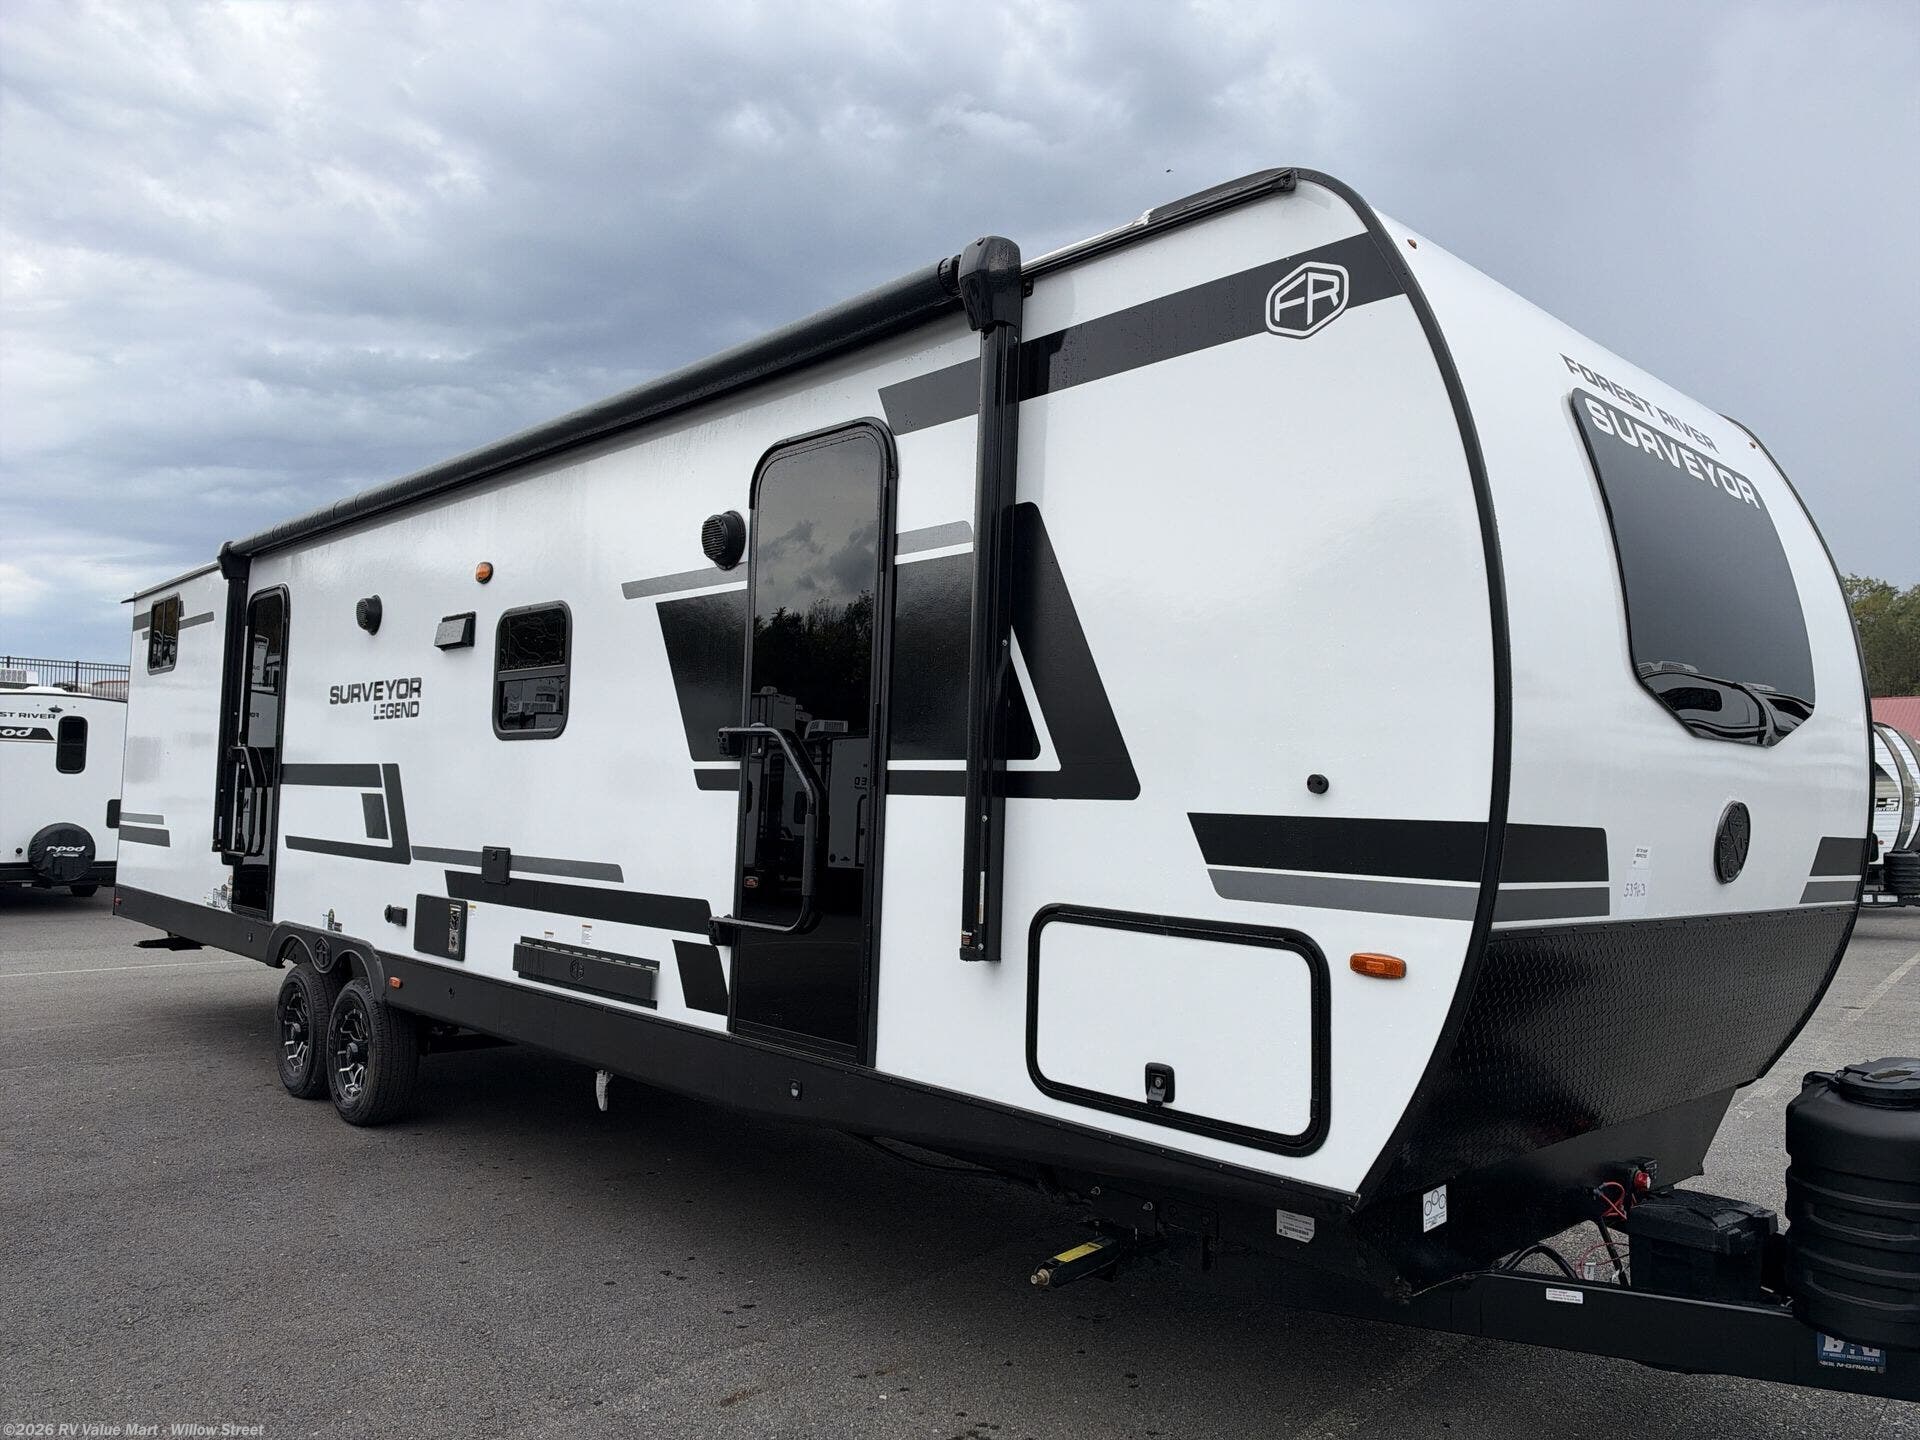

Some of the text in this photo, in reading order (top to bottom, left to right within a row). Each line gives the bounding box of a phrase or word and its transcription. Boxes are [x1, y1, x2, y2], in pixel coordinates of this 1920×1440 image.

[1559, 353, 1720, 454] FOREST RIVER
[1584, 397, 1761, 509] SURVEYOR
[329, 677, 422, 705] SURVEYOR
[373, 701, 420, 720] LEGEND
[0, 727, 33, 737] od
